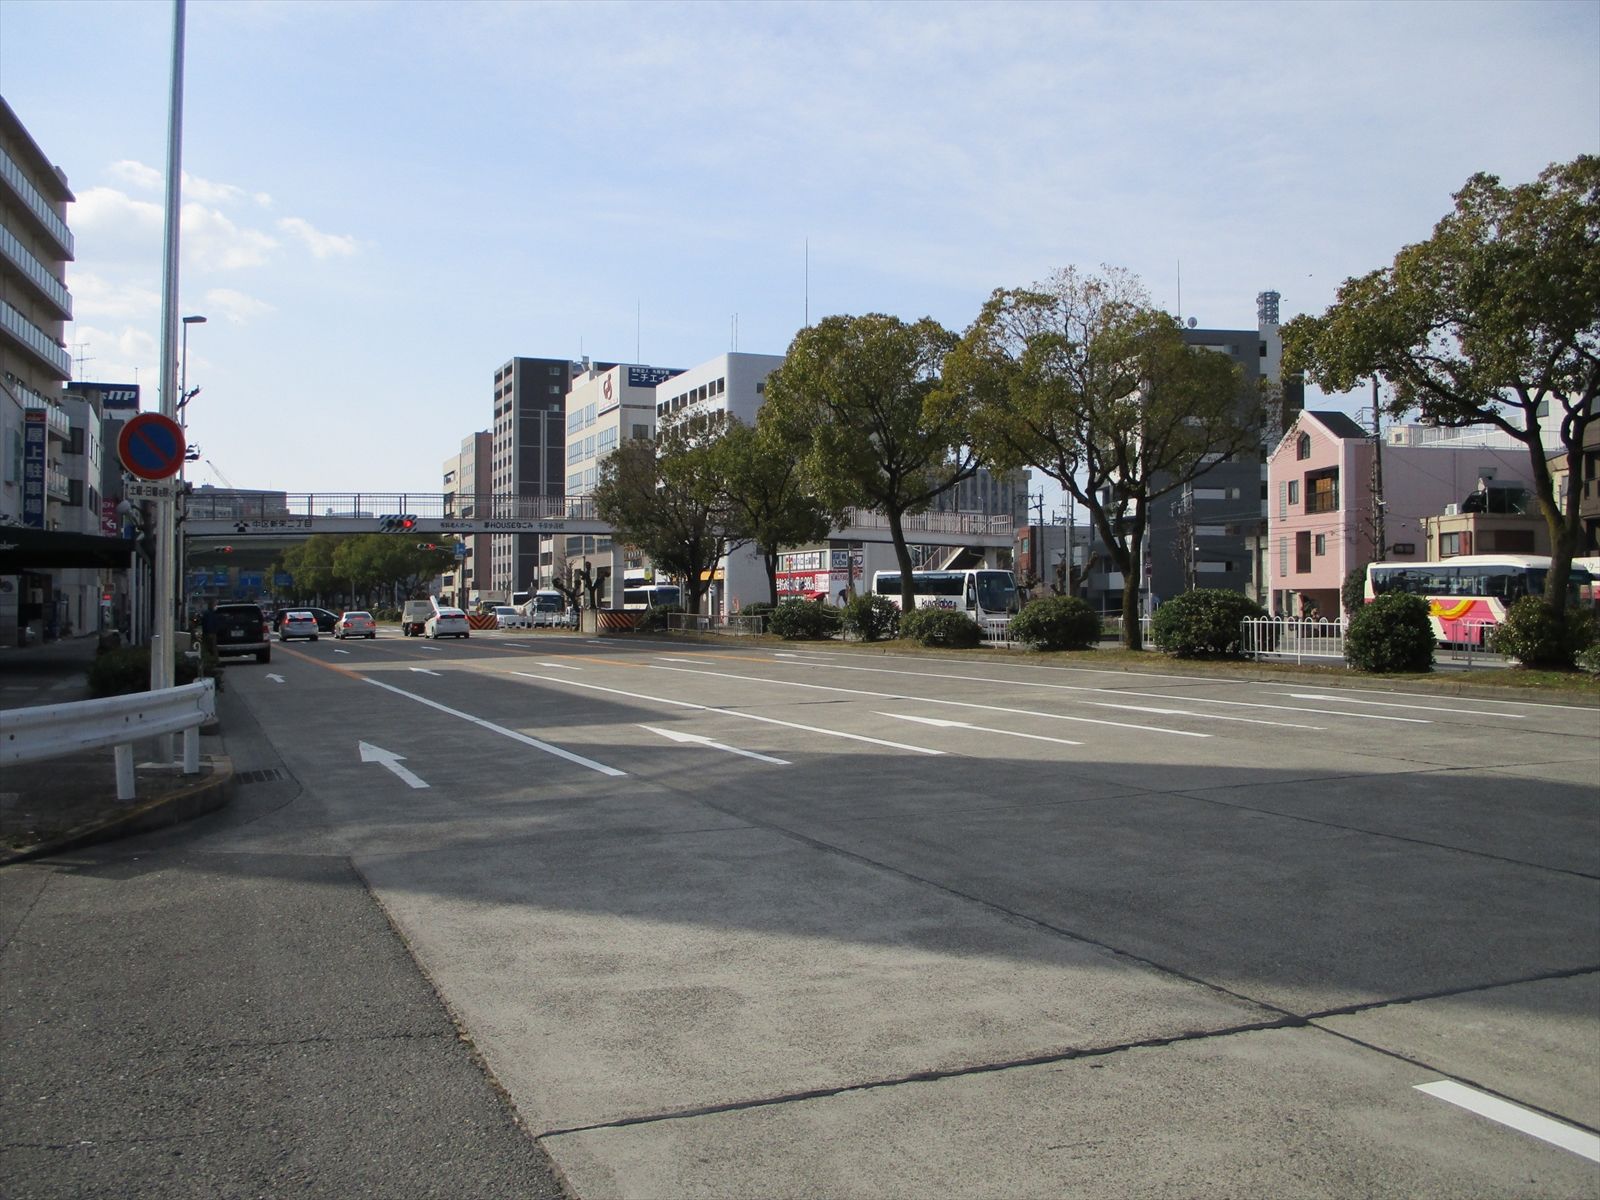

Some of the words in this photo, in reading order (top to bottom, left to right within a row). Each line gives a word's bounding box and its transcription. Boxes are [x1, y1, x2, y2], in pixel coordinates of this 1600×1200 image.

[25, 427, 43, 514] 屋上駐車場
[252, 519, 313, 528] 中区新栄二丁目
